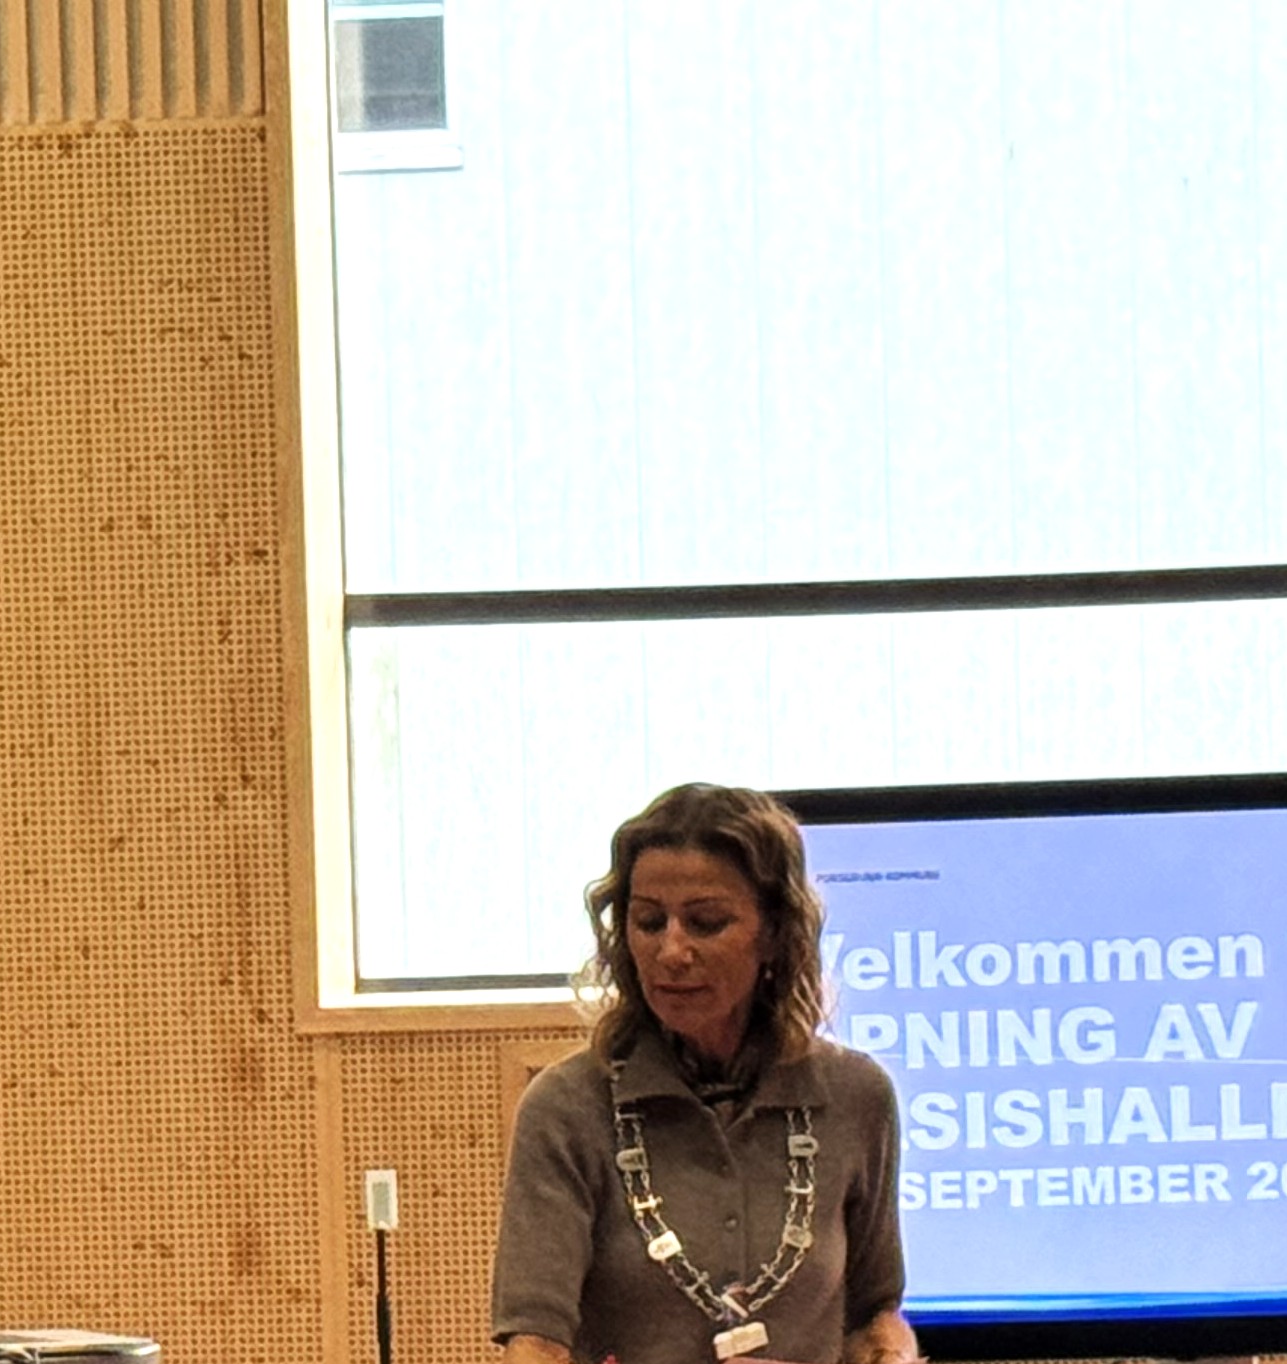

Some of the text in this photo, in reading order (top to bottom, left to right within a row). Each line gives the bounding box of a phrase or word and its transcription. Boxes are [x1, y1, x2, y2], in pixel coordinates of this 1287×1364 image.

[849, 1001, 1259, 1069] PNING AV
[899, 1162, 1233, 1211] SEPTEMBER
